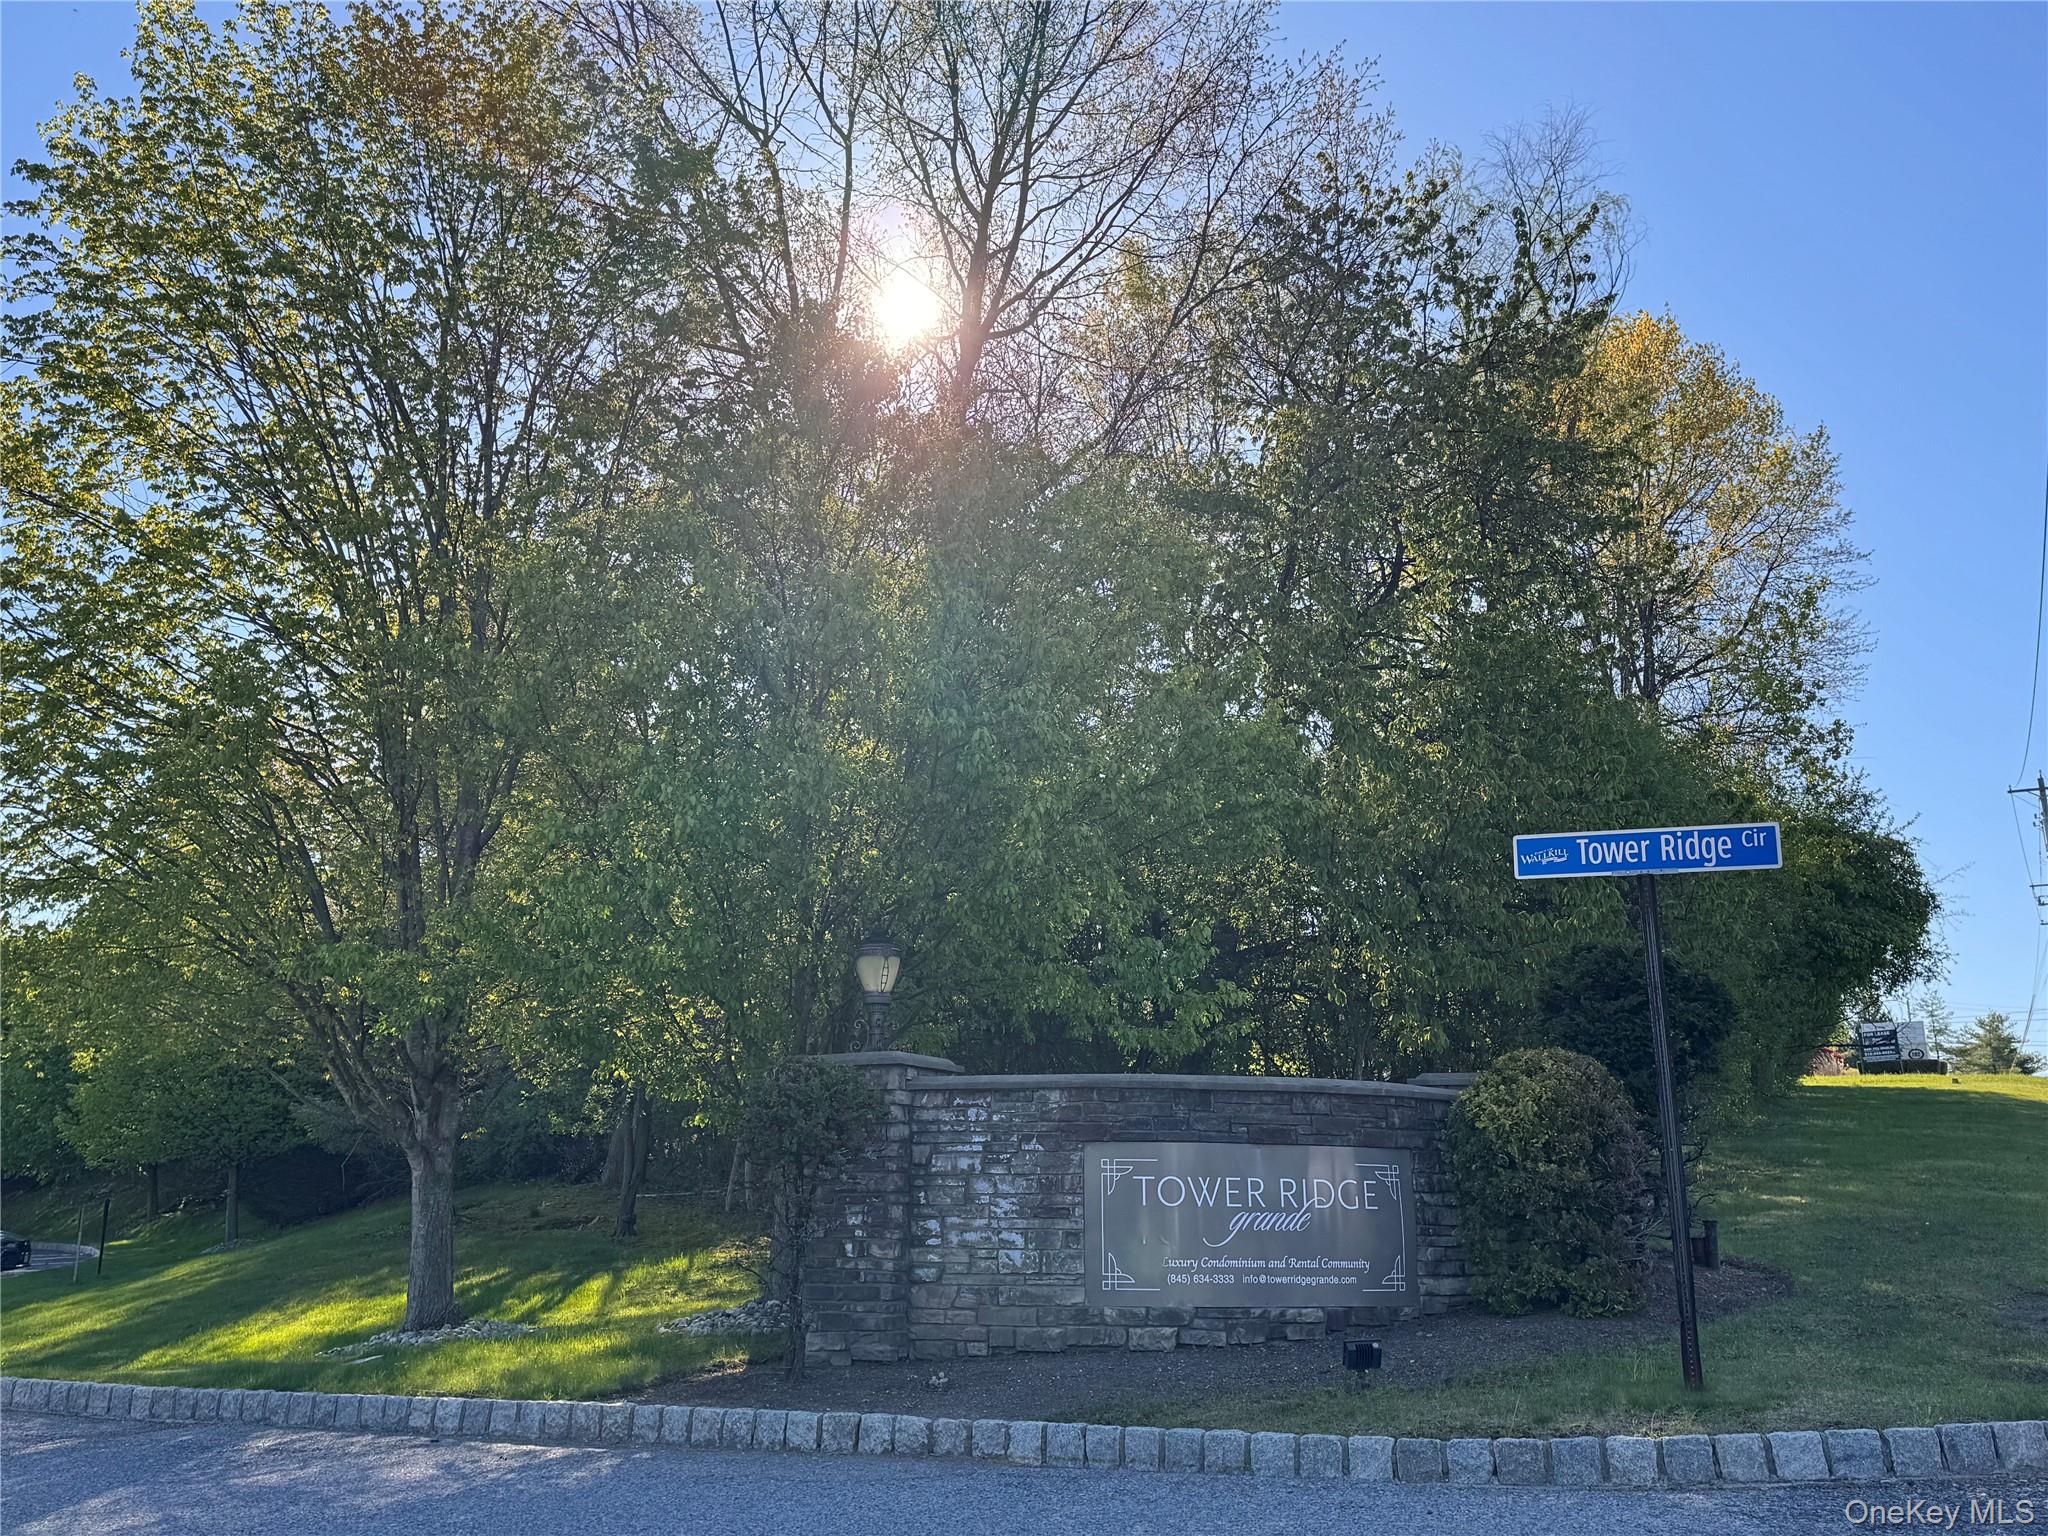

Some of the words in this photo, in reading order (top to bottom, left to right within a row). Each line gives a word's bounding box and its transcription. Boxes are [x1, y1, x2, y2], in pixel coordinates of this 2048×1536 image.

[1576, 838, 1650, 865] Tower
[1660, 831, 1732, 867] Ridge
[1741, 828, 1767, 848] Cir
[1132, 1176, 1266, 1208] TOWER
[1280, 1178, 1379, 1210] RIDGE
[1203, 1197, 1327, 1247] grande
[1162, 1256, 1198, 1272] Luxury
[1201, 1255, 1266, 1269] Condominium
[1268, 1256, 1288, 1269] and
[1288, 1256, 1320, 1269] Rental
[1321, 1257, 1370, 1273] Community
[1167, 1274, 1190, 1285] (845)
[1193, 1274, 1235, 1284] 634-3333
[1242, 1274, 1357, 1287] info@towerridgegrande.com
